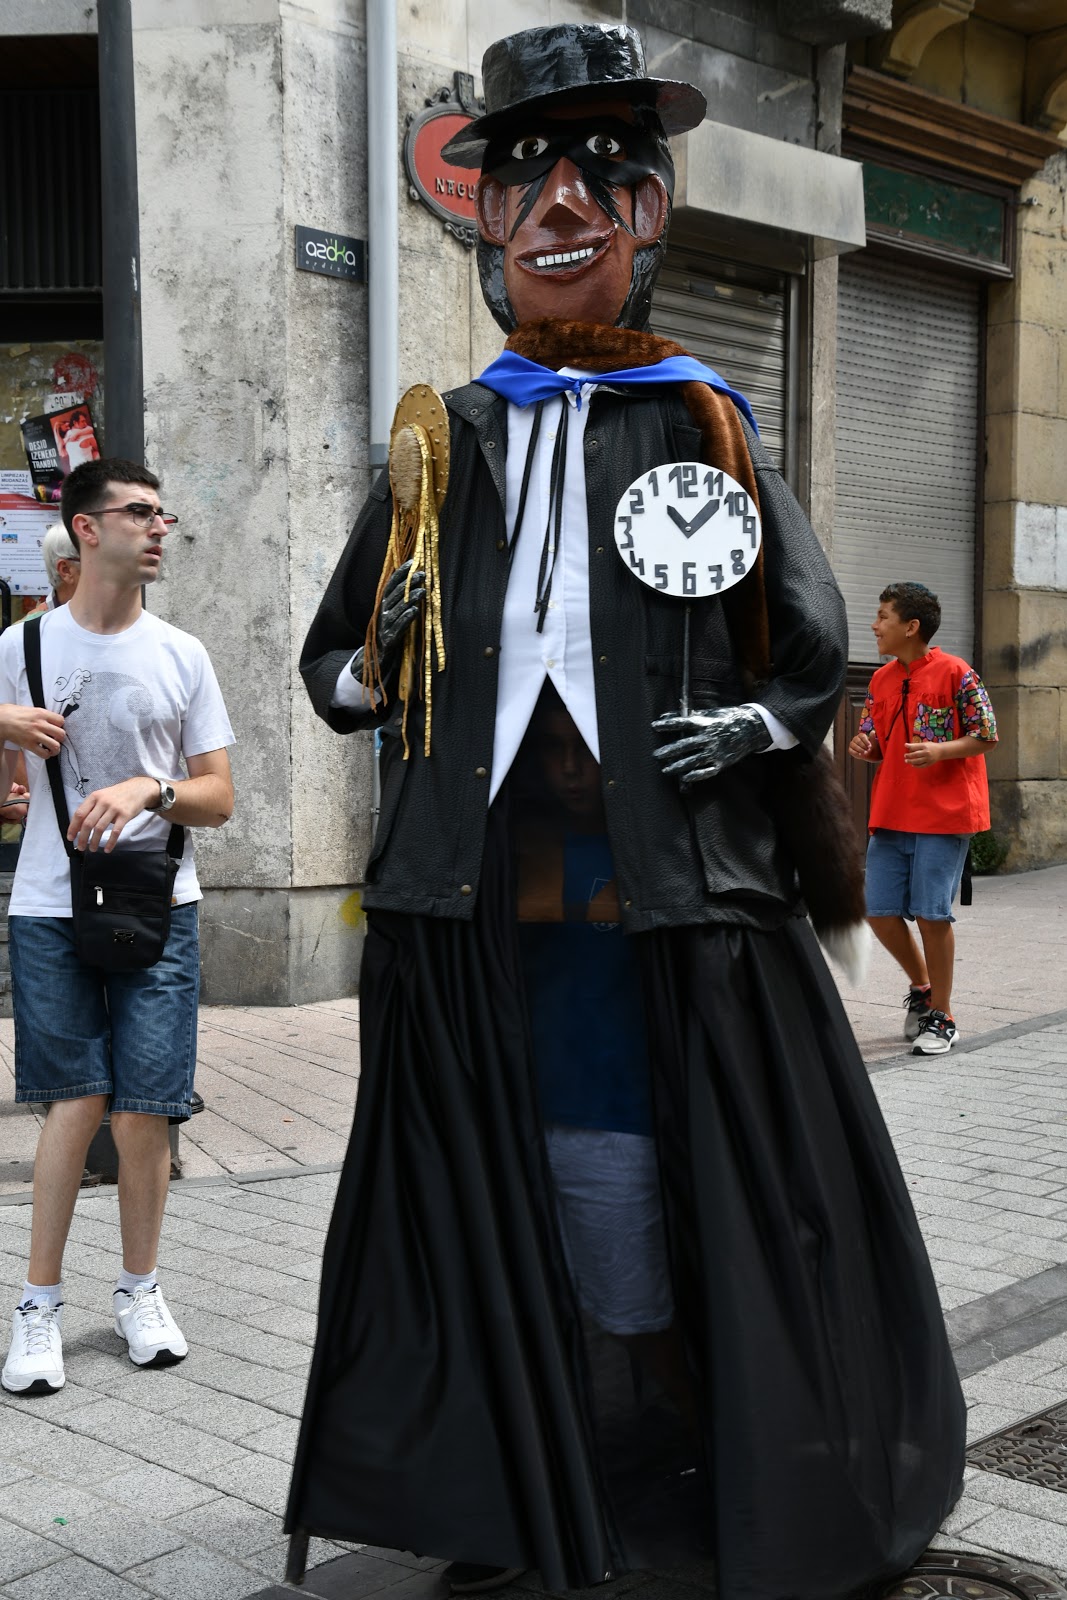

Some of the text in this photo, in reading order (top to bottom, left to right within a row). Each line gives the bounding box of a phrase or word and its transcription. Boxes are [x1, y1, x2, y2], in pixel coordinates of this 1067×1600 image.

[435, 176, 476, 199] NAGU
[29, 439, 48, 451] DESIO
[31, 447, 57, 461] IZENEKO
[32, 458, 58, 469] TRANBIA
[647, 471, 659, 497] 1
[668, 465, 699, 499] 12
[703, 471, 724, 497] 11
[629, 488, 645, 515] 2
[723, 491, 749, 517] 10
[618, 515, 635, 550] 3
[742, 515, 756, 549] 9
[629, 550, 645, 576] 4
[730, 549, 746, 576] 8
[654, 563, 669, 590] 5
[682, 562, 697, 595] 6
[707, 564, 725, 591] 7
